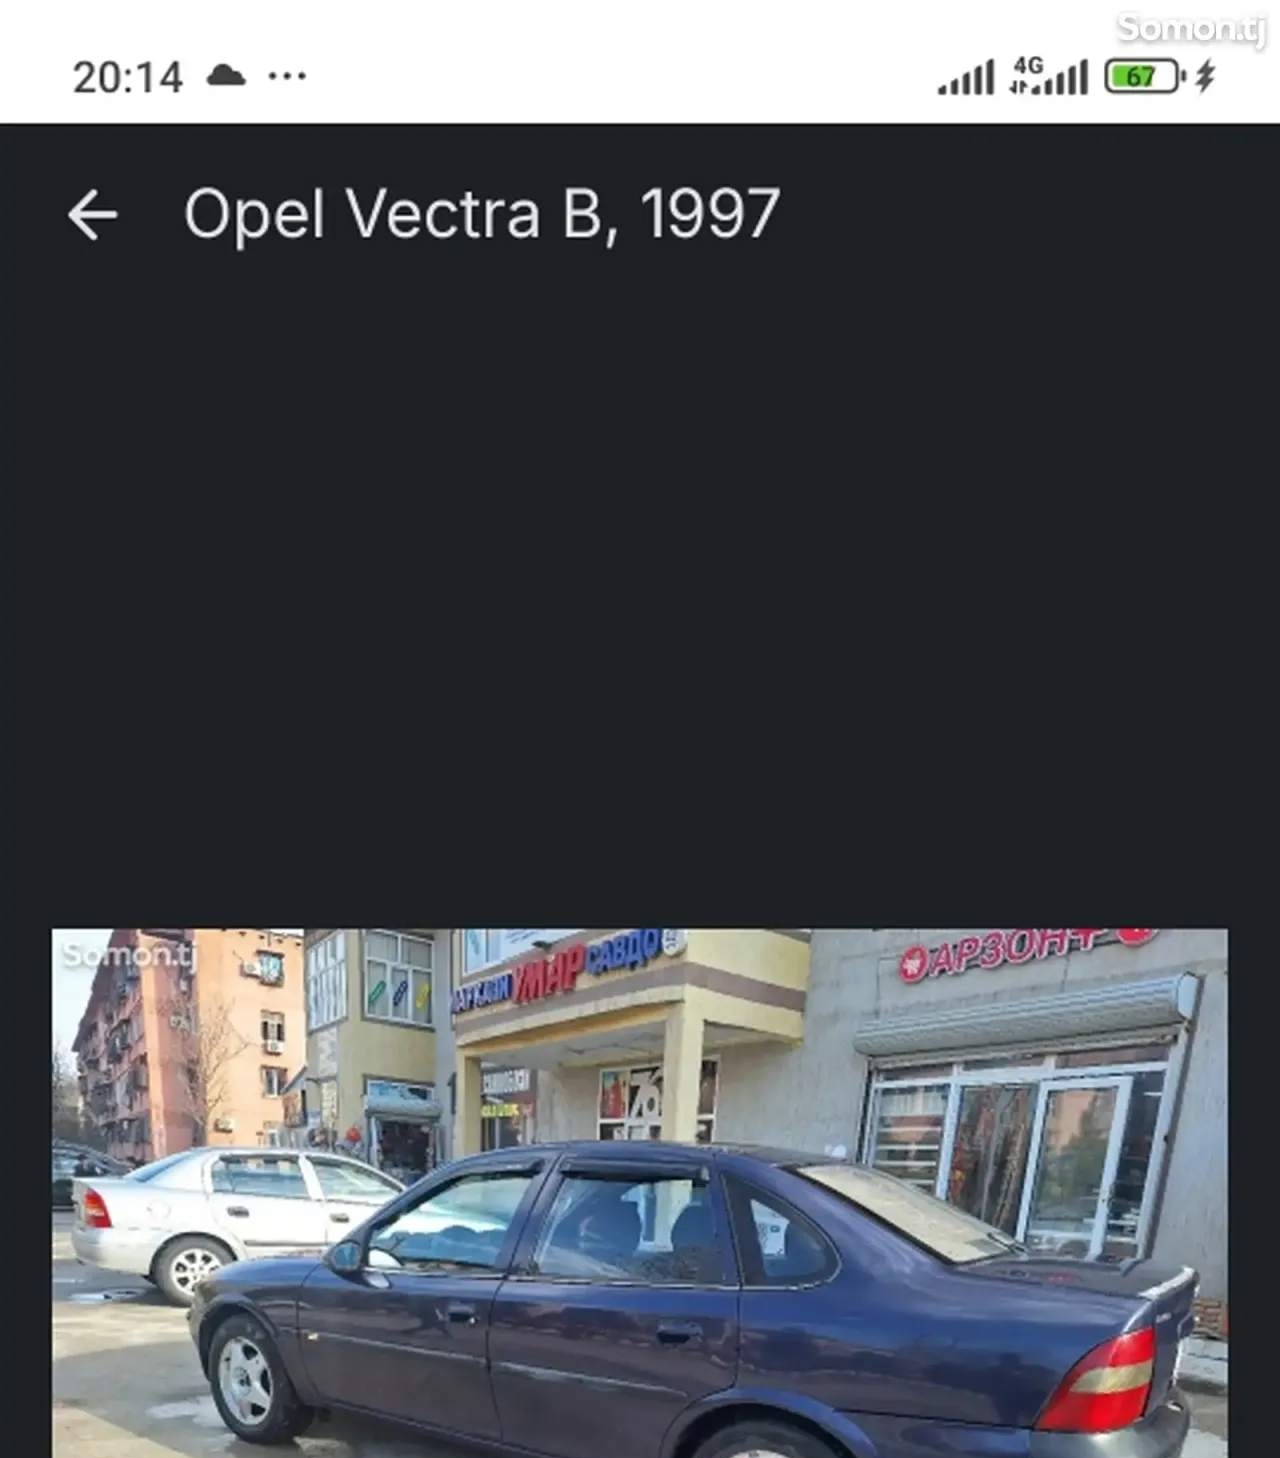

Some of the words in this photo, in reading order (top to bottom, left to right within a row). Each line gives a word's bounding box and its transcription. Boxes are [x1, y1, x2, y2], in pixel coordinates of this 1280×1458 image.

[73, 60, 184, 94] 20:14
[1013, 56, 1044, 75] 4G
[1126, 66, 1157, 88] 67
[185, 186, 323, 252] Opel
[345, 187, 539, 240] Vectra
[565, 187, 617, 249] B,
[641, 186, 781, 240] 1997
[585, 928, 661, 974] САВДО
